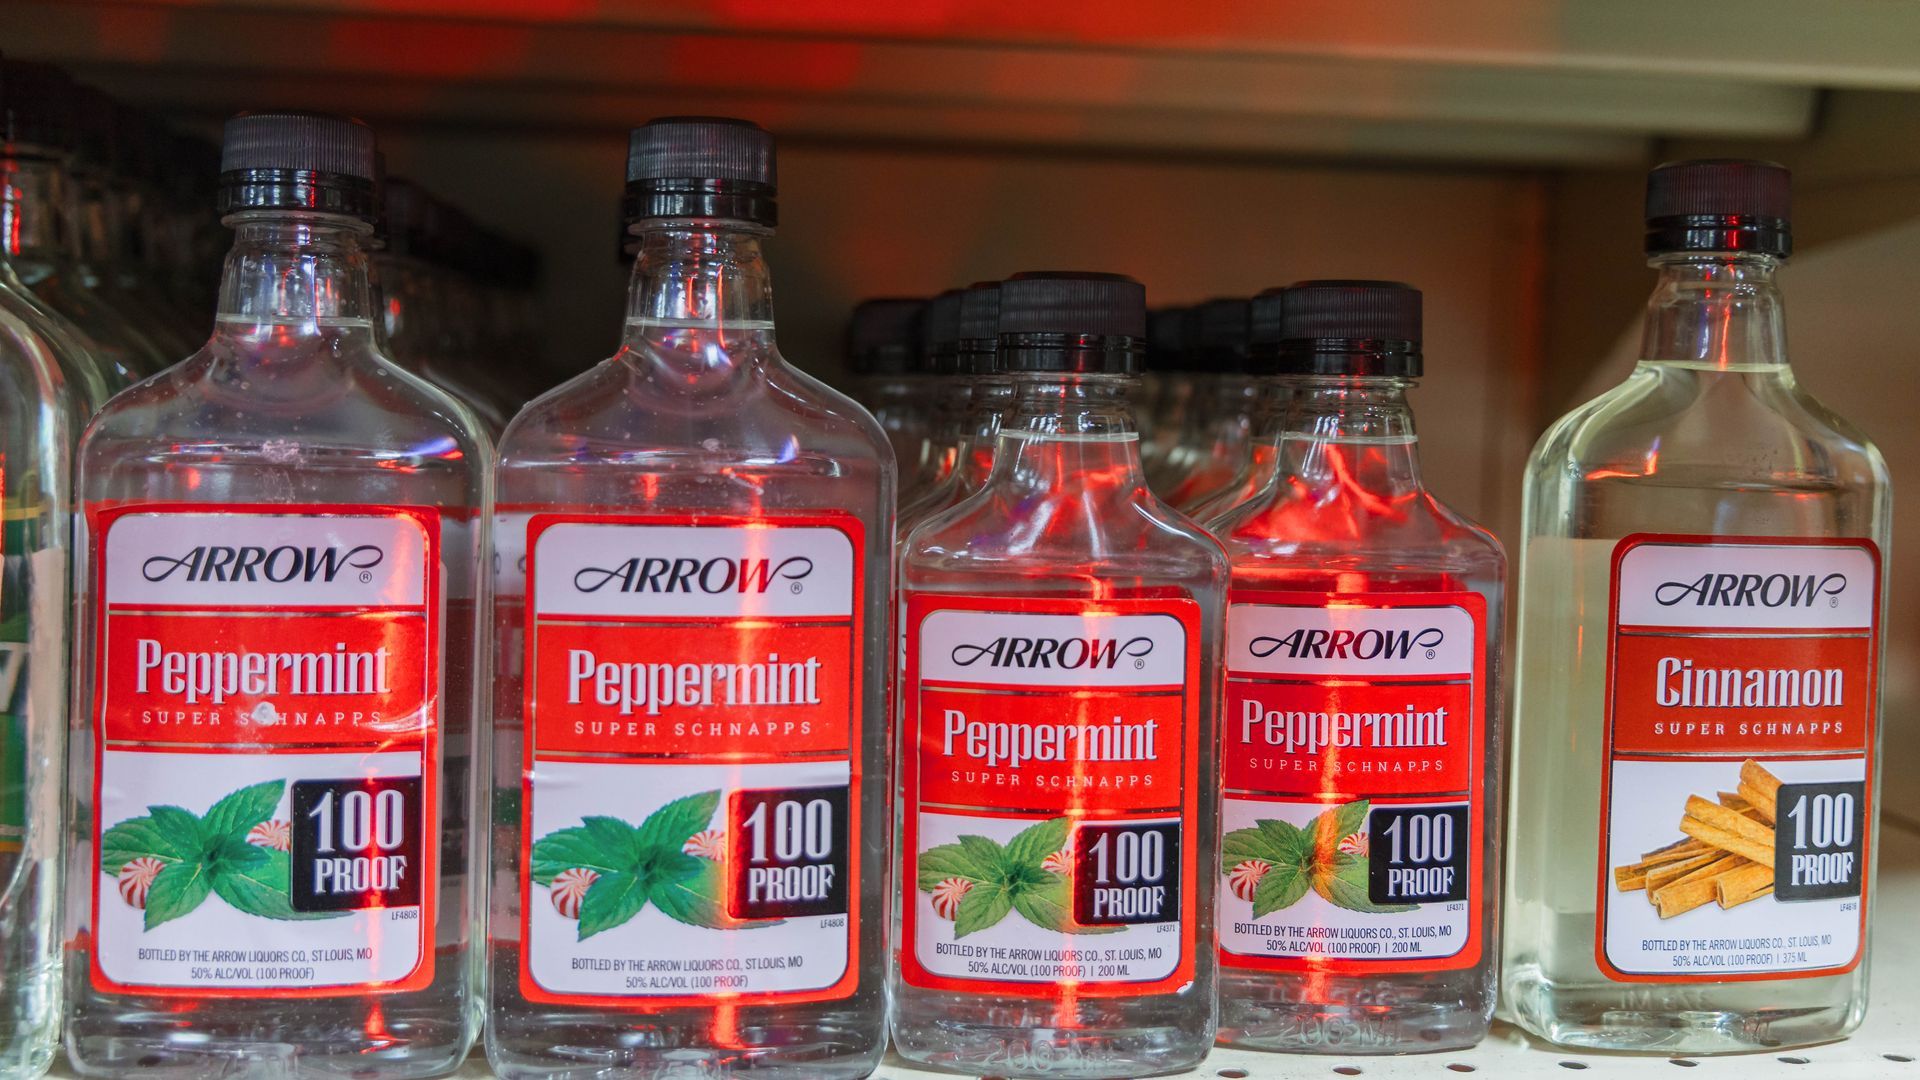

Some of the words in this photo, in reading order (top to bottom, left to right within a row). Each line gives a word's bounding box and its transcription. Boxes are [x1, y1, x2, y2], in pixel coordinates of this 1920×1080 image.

[142, 545, 383, 583] ARROW
[574, 556, 813, 594] ARROW
[1655, 573, 1847, 608] ARROW
[951, 636, 1154, 670] ARROW
[1249, 627, 1444, 660] ARROW
[136, 639, 392, 704] Peppermint
[567, 649, 821, 716] Peppermint
[1656, 656, 1844, 708] Cinnamon
[143, 711, 220, 725] SUPER
[239, 711, 381, 726] SHNAPPS
[575, 720, 656, 735] SUPER
[674, 721, 812, 736] SCHNAPPS
[1240, 699, 1448, 755] Peppermint
[1654, 722, 1725, 735] SUPER
[1739, 722, 1842, 735] SCHNAPPS
[942, 709, 1159, 768] Peppermint
[952, 771, 1020, 785] SUPER
[1036, 774, 1153, 788] SCHNAPPS
[1250, 757, 1318, 771] SUPER
[1334, 759, 1443, 773] SCHNAPPS
[309, 789, 405, 852] 100
[743, 799, 832, 863] 100
[1787, 792, 1854, 849] 100
[1383, 814, 1453, 864] 100
[1088, 830, 1164, 883] 100
[1791, 851, 1854, 887] PROOF
[314, 855, 408, 894] PROOF
[748, 864, 835, 903] PROOF
[1387, 866, 1455, 898] PROOF
[391, 909, 418, 921] LF4808
[1093, 886, 1166, 919] PROOF
[1446, 903, 1464, 912] LF4371
[1234, 922, 1272, 936] BOTTLED
[1274, 925, 1286, 937] BY
[1288, 926, 1305, 938] THE
[1306, 926, 1339, 939] ARROW
[1341, 927, 1378, 940] LIQUORS
[1412, 926, 1437, 939] LOUIS,
[1439, 925, 1452, 937] MO
[1266, 939, 1287, 951] 50%
[1289, 941, 1325, 953] ALC/VOL
[1327, 941, 1348, 955] (100
[1349, 942, 1381, 955] PROOF)
[1392, 942, 1408, 953] 200
[1409, 942, 1422, 953] ML
[1642, 939, 1678, 951] BOTTLED
[1679, 939, 1691, 951] BY
[1692, 939, 1707, 950] THE
[1708, 938, 1737, 950] ARROW
[1739, 937, 1770, 950] LIQUORS
[138, 948, 176, 961] BOTTLED
[179, 950, 191, 961] BY
[193, 950, 210, 962] THE
[212, 951, 247, 962] ARROW
[249, 951, 289, 962] LIQUORS
[356, 947, 372, 960] MO
[572, 957, 611, 971] BOTTLED
[613, 959, 625, 971] BY
[628, 960, 645, 972] THE
[647, 960, 682, 972] ARROW
[684, 959, 723, 972] LIQUORS
[788, 955, 803, 968] MO
[936, 942, 974, 957] BOTTLED
[976, 946, 988, 958] BY
[990, 946, 1007, 959] THE
[1009, 948, 1042, 961] ARROW
[1044, 949, 1083, 962] LIQUORS
[1119, 948, 1147, 962] LOUIS,
[1148, 947, 1162, 959] MO
[1673, 955, 1690, 967] 50%
[1693, 954, 1725, 967] ALC/VOL
[1727, 954, 1744, 966] (100
[1746, 953, 1773, 965] PROOF)
[1783, 952, 1796, 963] 375
[1797, 952, 1807, 962] ML
[191, 967, 213, 979] 50%
[215, 967, 253, 980] ALC/VOL
[256, 967, 277, 980] (100
[279, 967, 315, 980] PROOF)
[626, 976, 648, 988] 50%
[650, 976, 688, 989] ALC/VOL
[691, 976, 712, 989] (100
[714, 975, 748, 988] PROOF)
[968, 961, 988, 974] 50%
[991, 963, 1028, 976] ALC/VOL
[1030, 964, 1051, 978] (100
[1052, 965, 1086, 978] PROOF)
[1098, 965, 1115, 976] 200
[1117, 965, 1130, 976] ML
